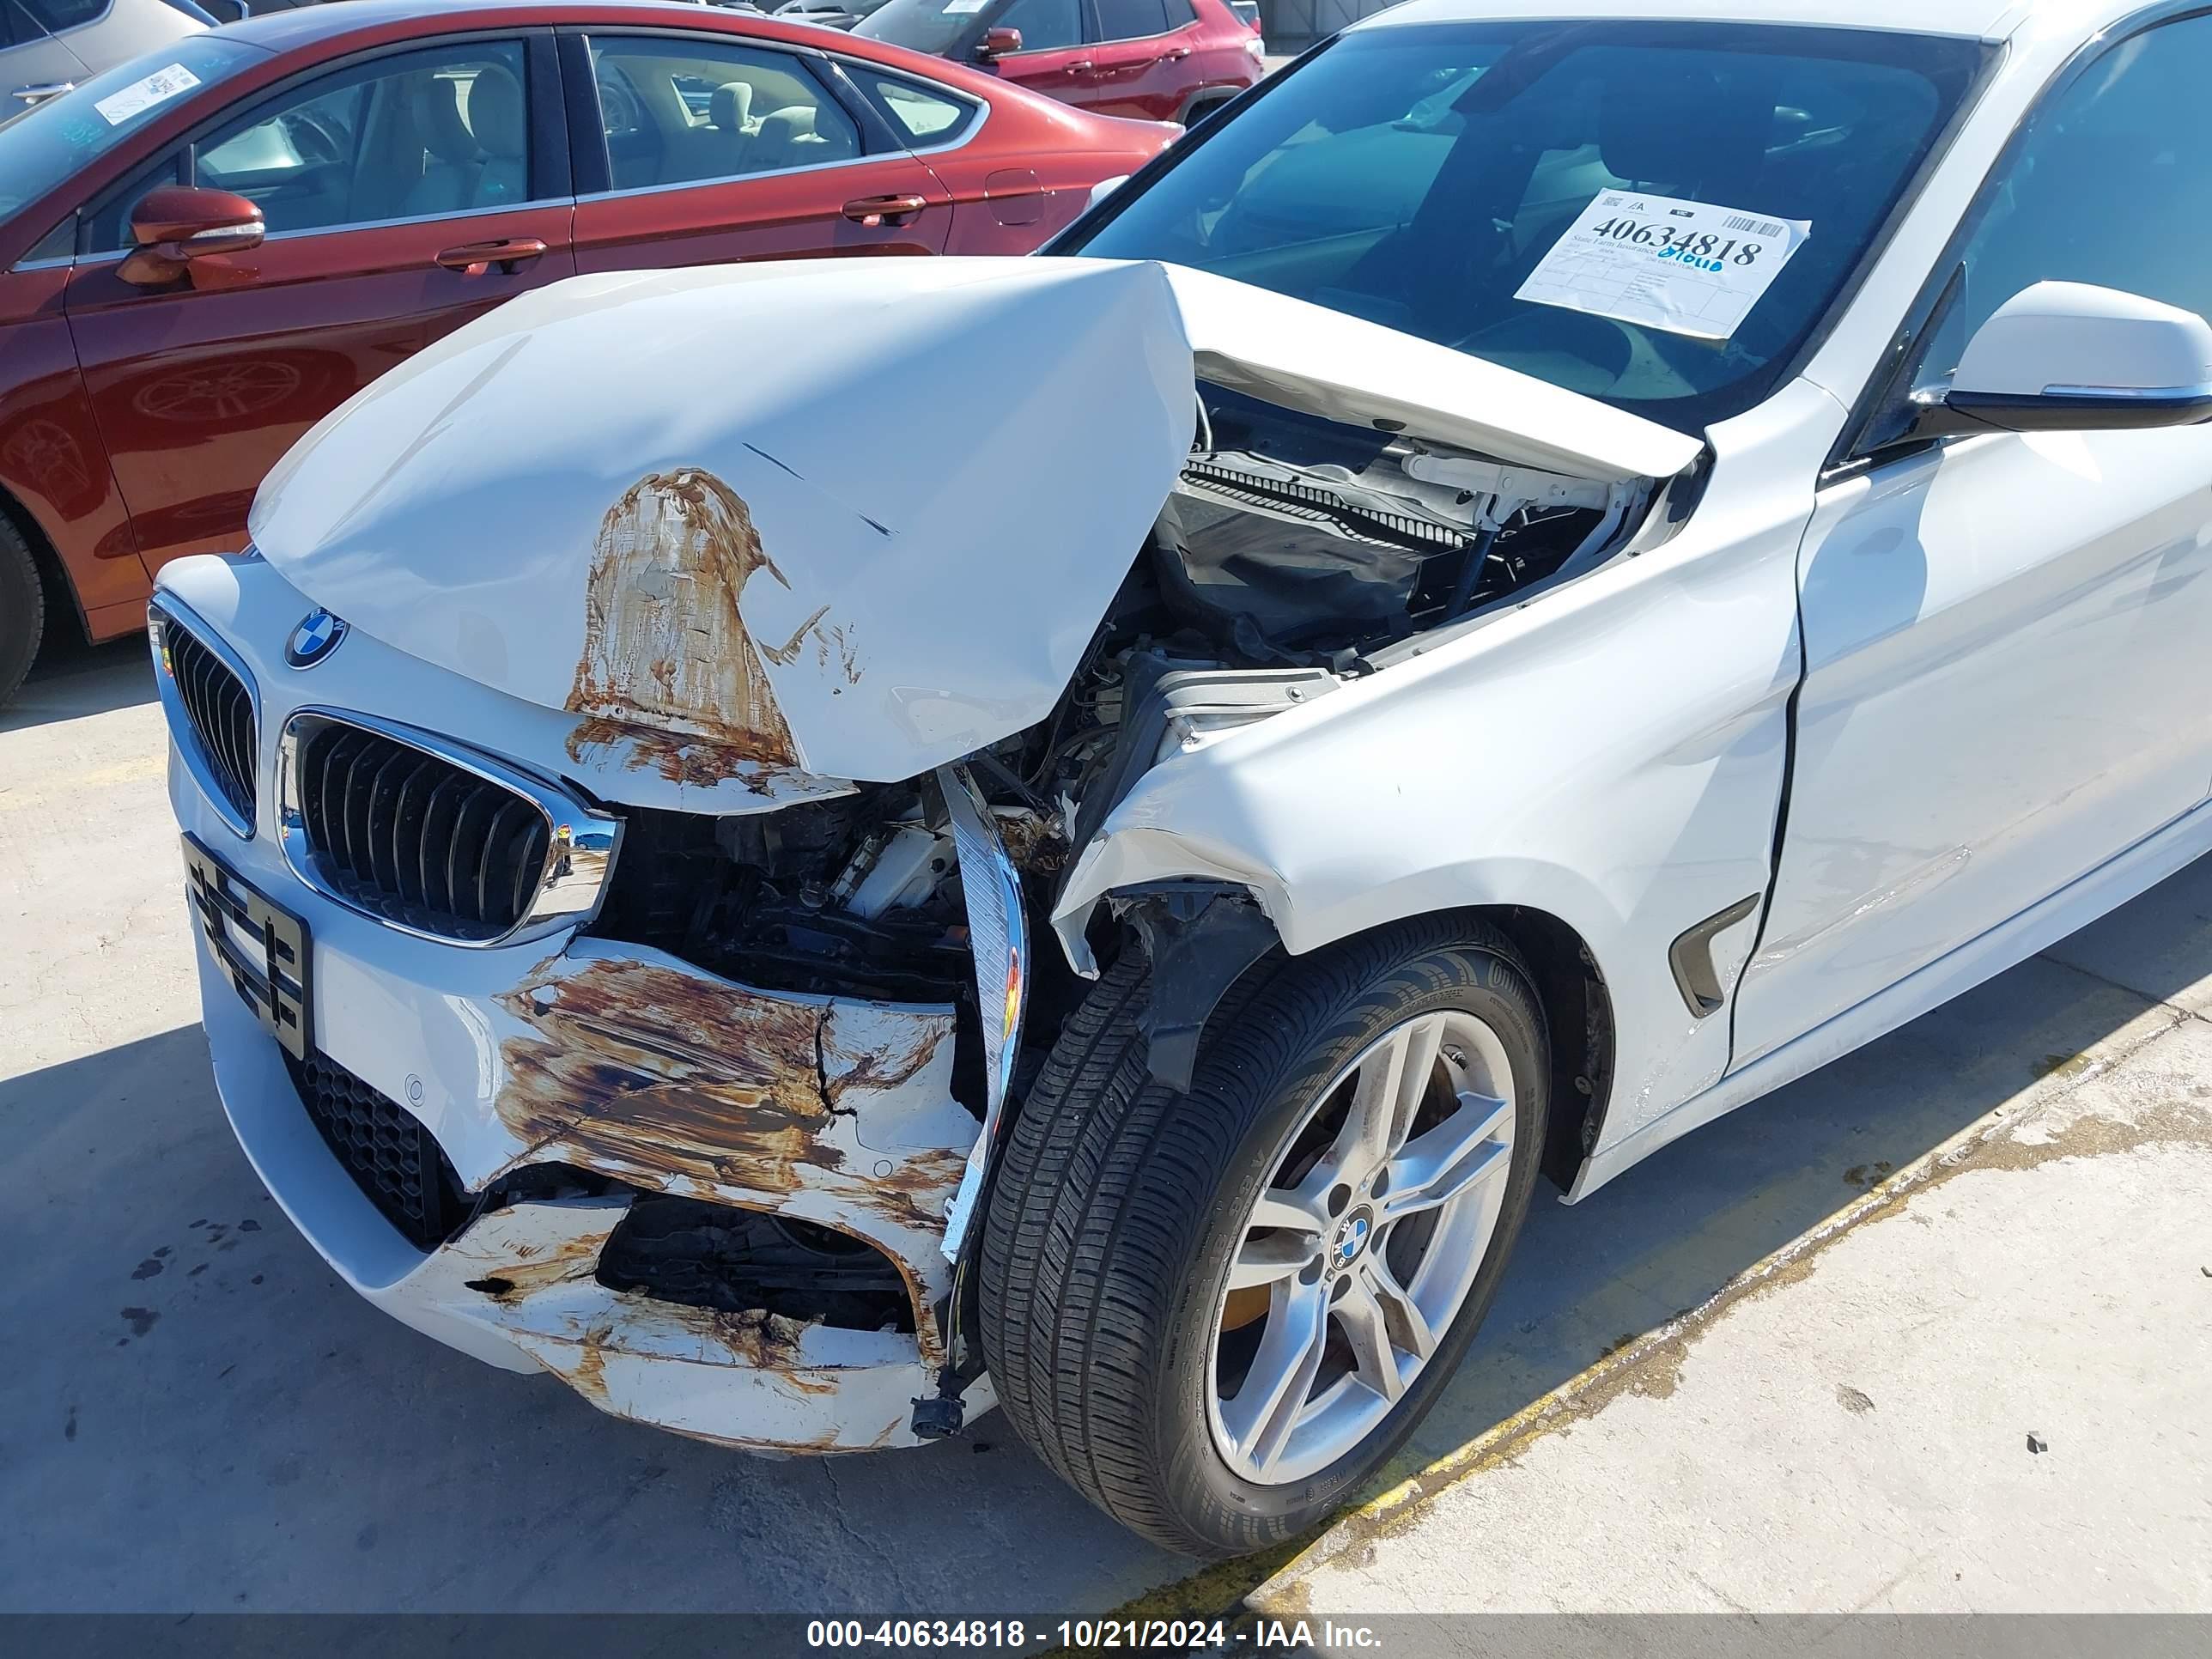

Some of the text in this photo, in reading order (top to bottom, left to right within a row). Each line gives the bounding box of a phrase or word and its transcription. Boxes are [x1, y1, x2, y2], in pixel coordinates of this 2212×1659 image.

[1571, 234, 1593, 244] State
[1593, 237, 1615, 248] Farm
[1615, 240, 1657, 255] Insurance
[1592, 216, 1763, 266] 40634818
[309, 606, 345, 631] BW
[1334, 1218, 1352, 1267] BMW
